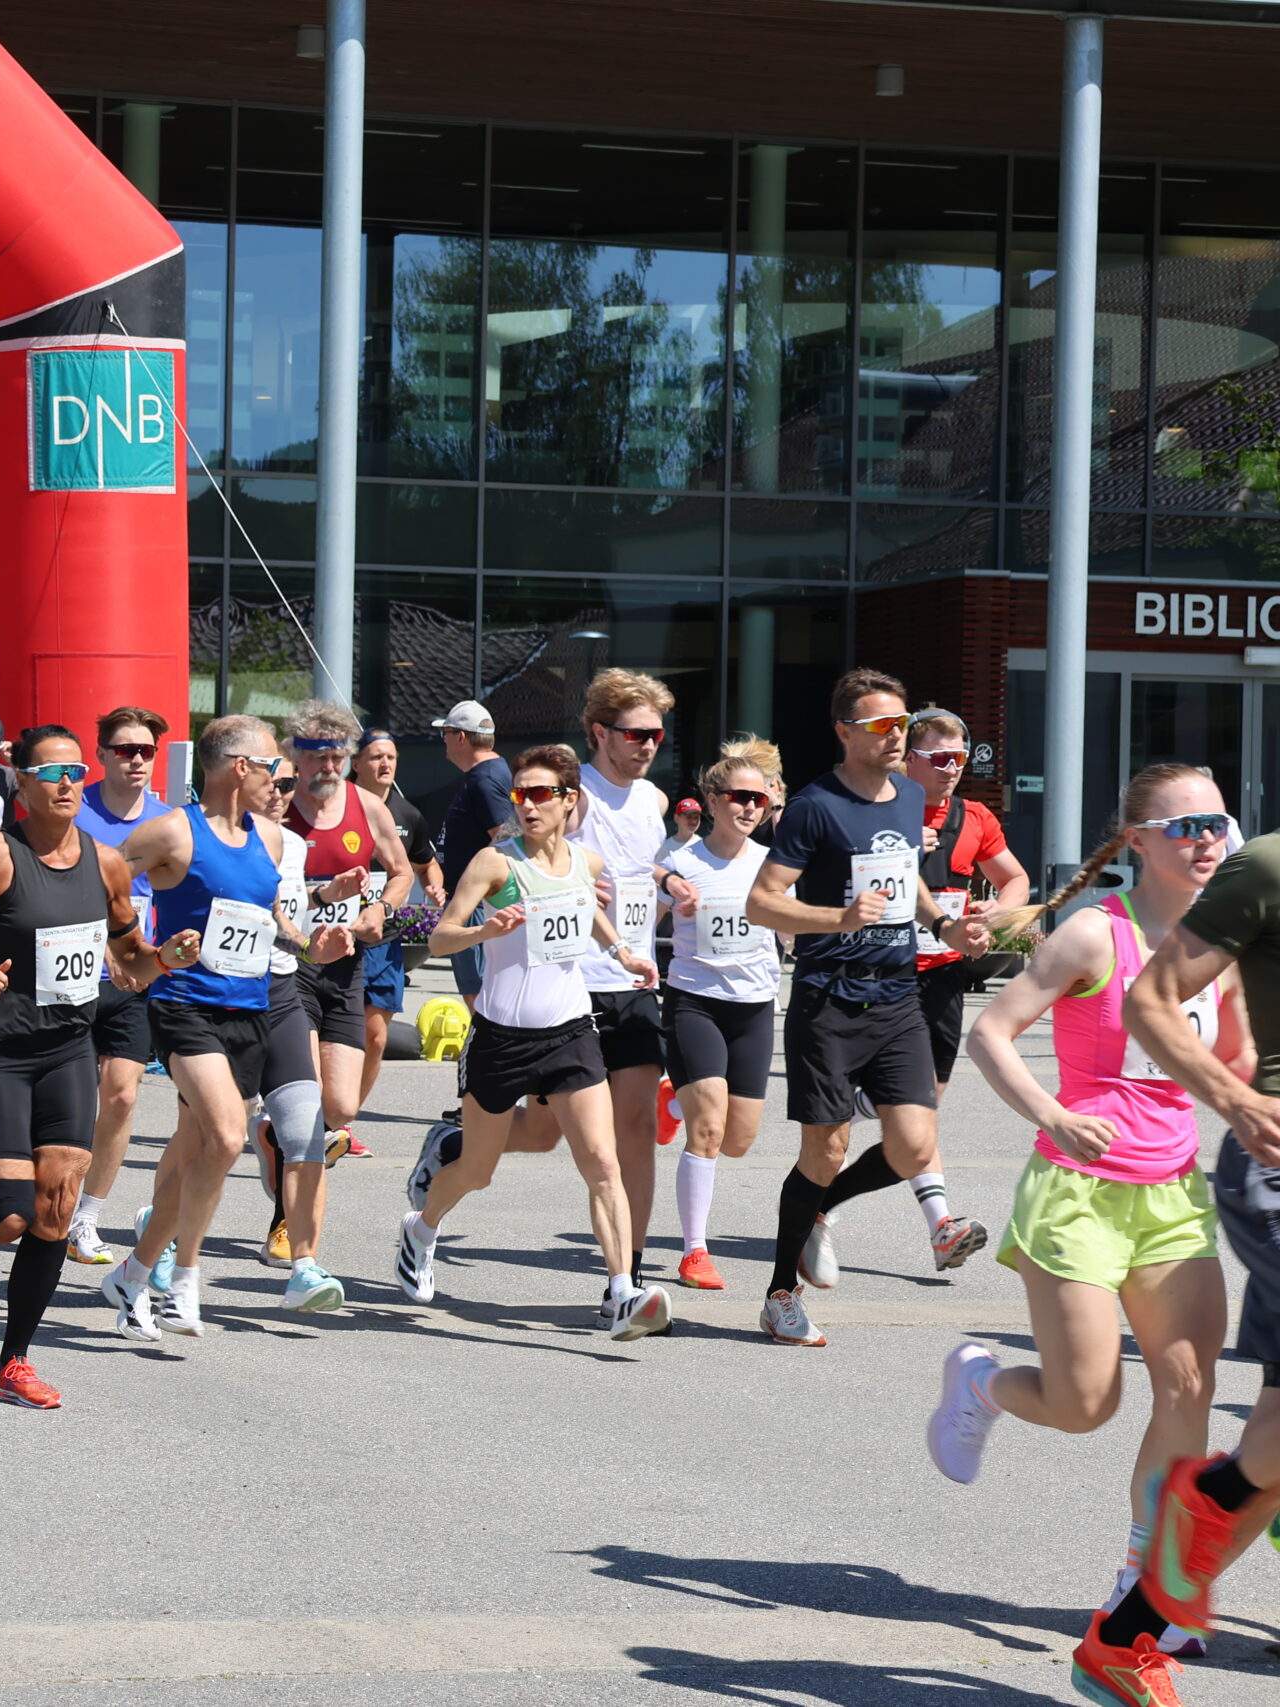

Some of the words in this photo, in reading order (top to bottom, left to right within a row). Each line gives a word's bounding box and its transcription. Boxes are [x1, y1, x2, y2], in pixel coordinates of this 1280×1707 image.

[53, 350, 165, 488] DNB
[280, 898, 297, 920] 79
[311, 903, 348, 923] 292
[624, 903, 648, 926] 203
[543, 913, 579, 942] 201
[711, 916, 750, 937] 215
[219, 926, 258, 954] 271
[55, 950, 94, 981] 209
